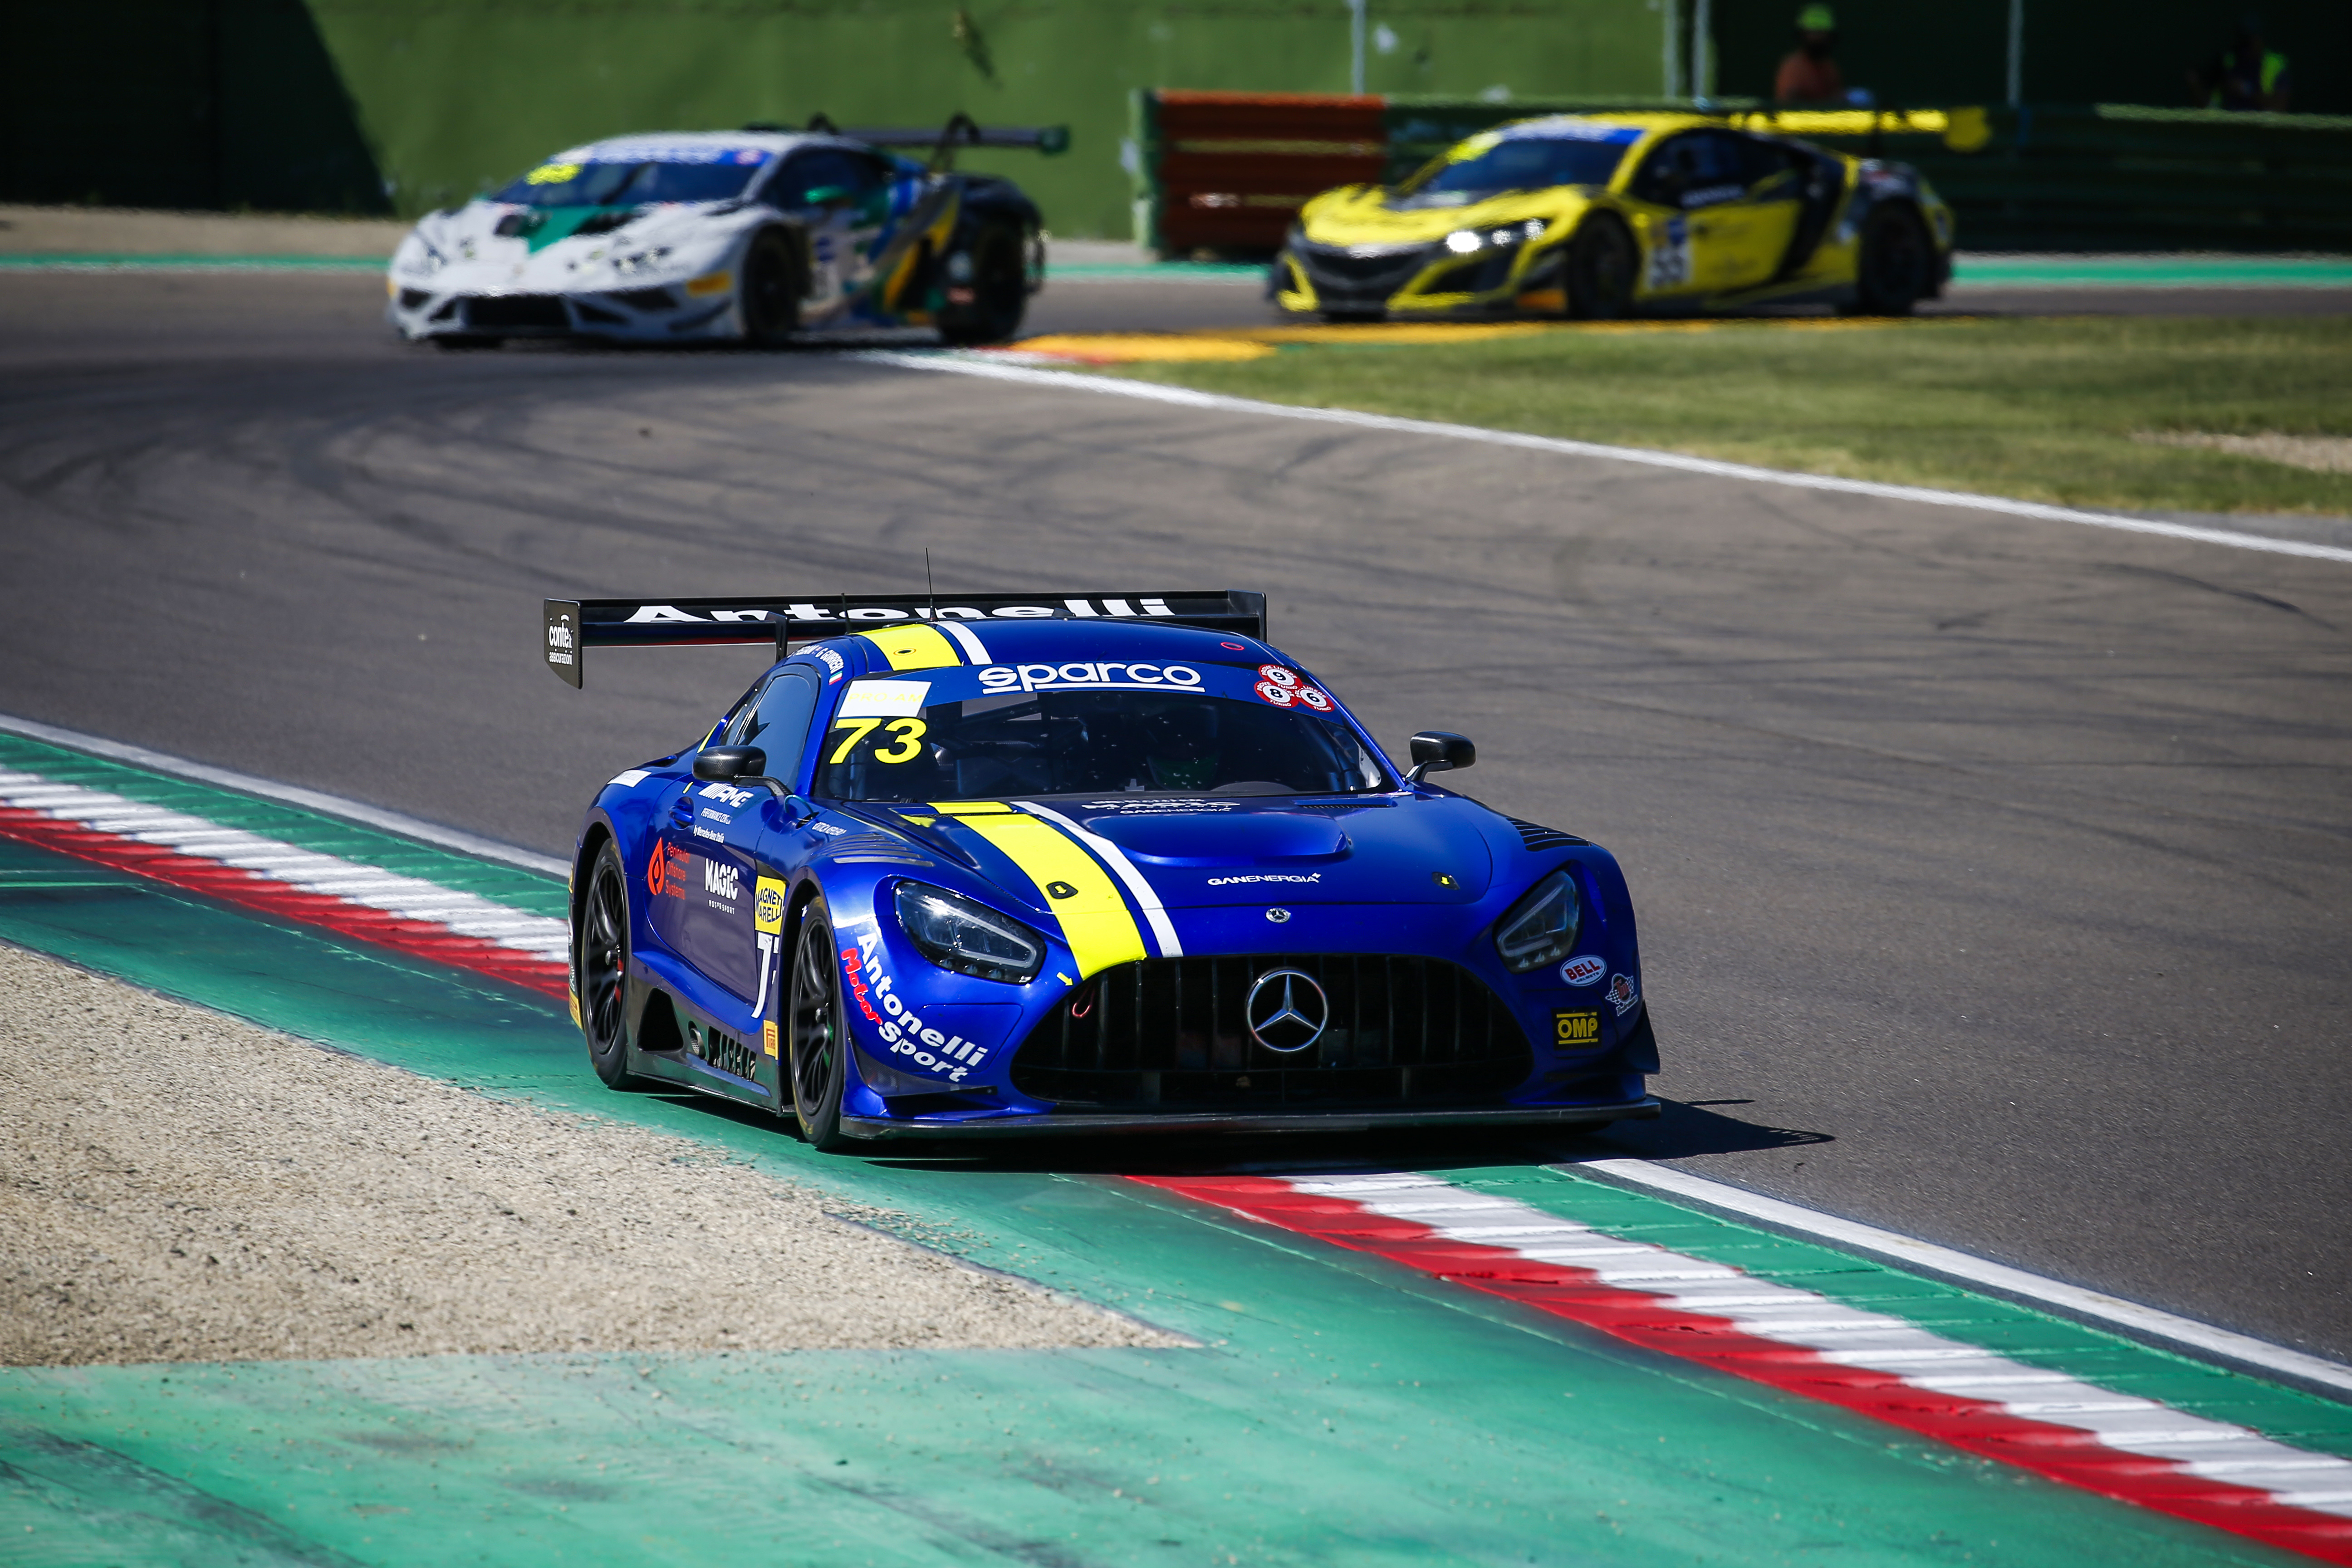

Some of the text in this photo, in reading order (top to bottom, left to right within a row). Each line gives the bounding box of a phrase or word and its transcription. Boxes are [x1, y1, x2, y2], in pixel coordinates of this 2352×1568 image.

[623, 599, 1175, 623] Antonelli
[978, 663, 1201, 692] sparco
[1272, 671, 1286, 681] 9
[847, 692, 924, 703] PRO-AM
[1269, 688, 1283, 698] 8
[1306, 692, 1320, 702] 6
[829, 718, 927, 764] 73
[710, 784, 754, 808] AMG
[1207, 875, 1319, 885] GANENERGIA
[1564, 960, 1601, 980] BELL
[1576, 971, 1599, 983] HELMETS
[857, 932, 988, 1067] Antonelli
[1558, 1018, 1597, 1038] OMP
